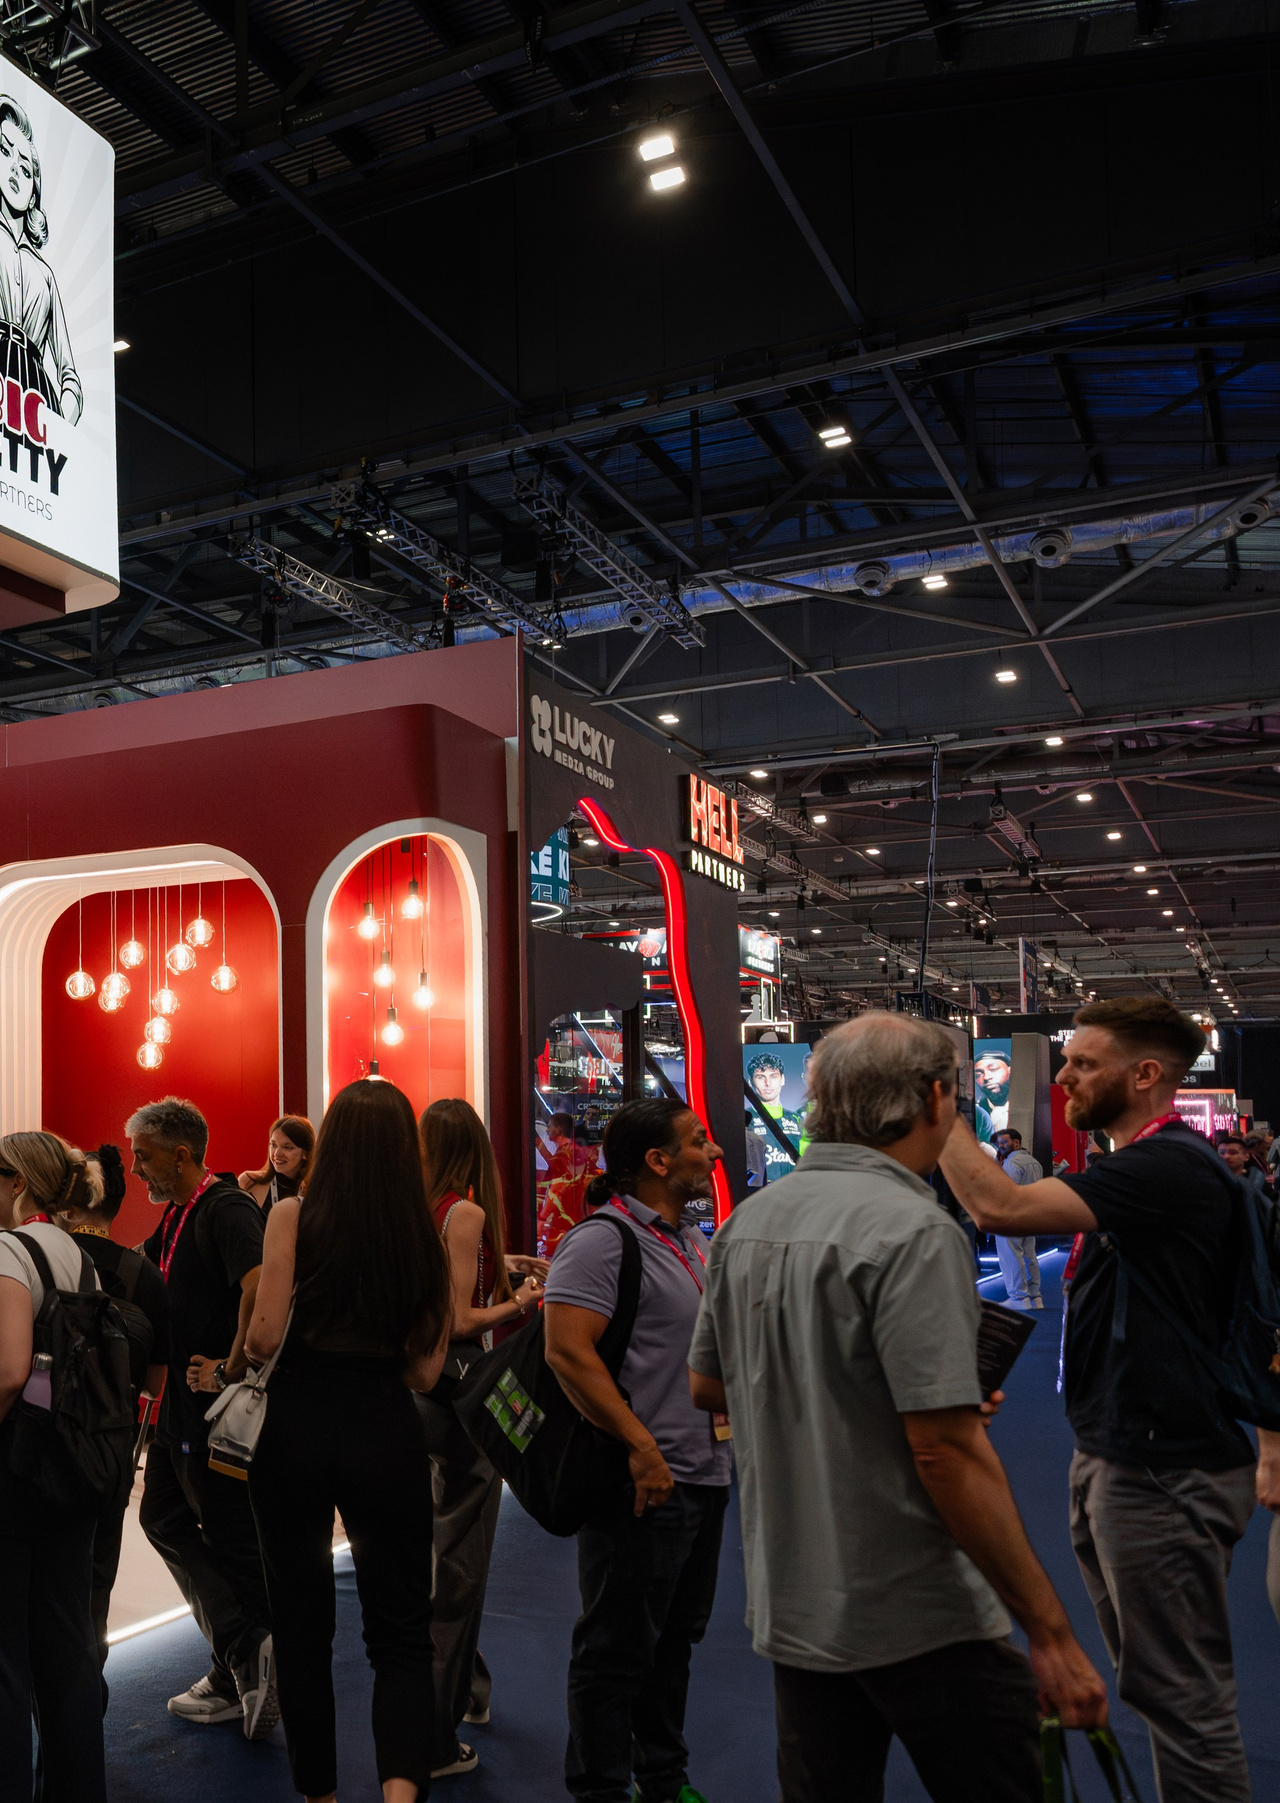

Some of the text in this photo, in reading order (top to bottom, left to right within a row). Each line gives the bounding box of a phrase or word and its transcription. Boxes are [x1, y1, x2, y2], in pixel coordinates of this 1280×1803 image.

[553, 705, 615, 769] LUCKY
[554, 749, 615, 790] MEDIA GROUP
[690, 773, 744, 865] HELL
[692, 849, 746, 892] PARTNERS
[765, 1144, 796, 1166] Sta
